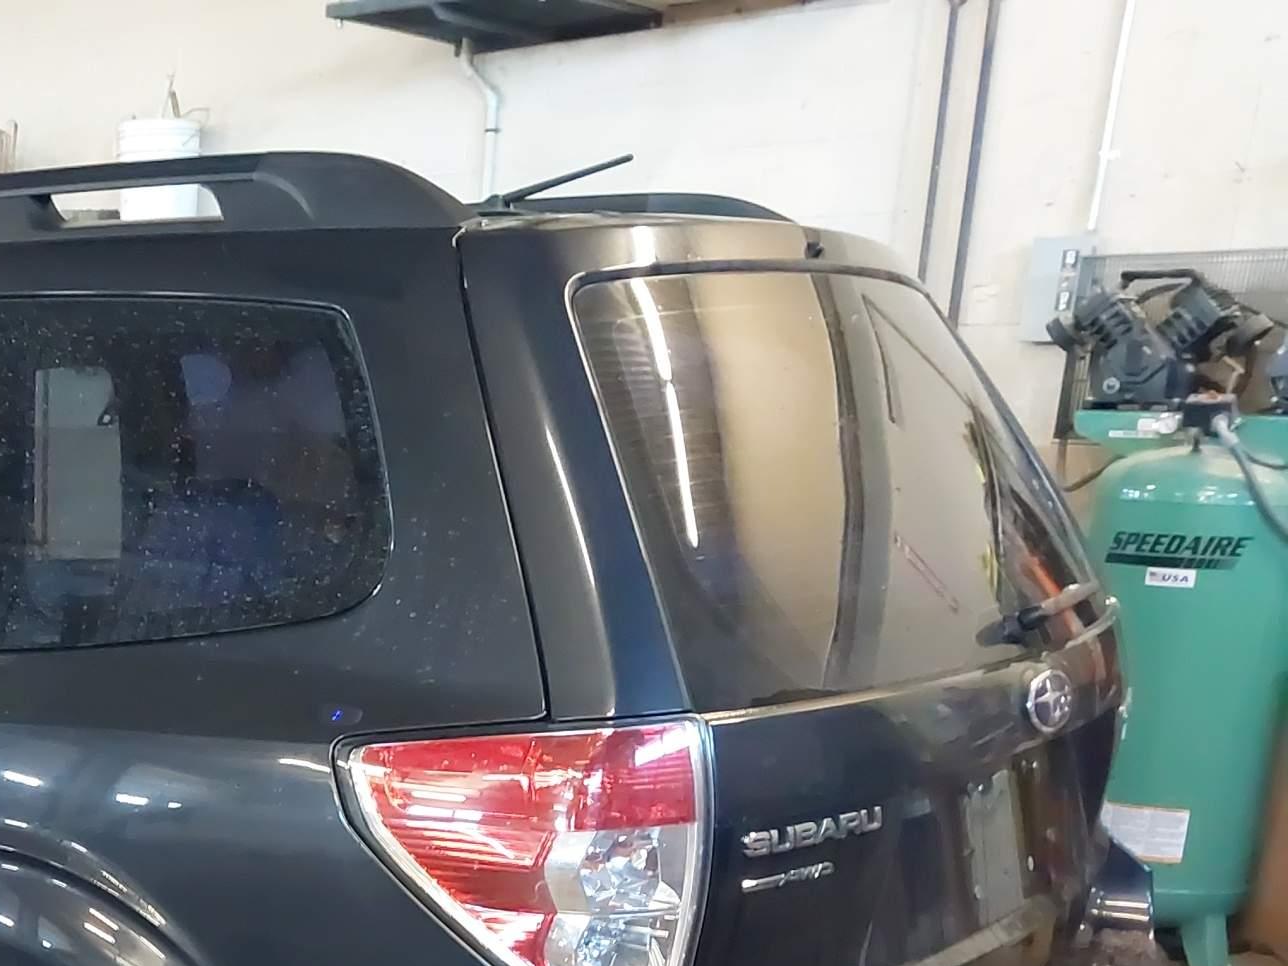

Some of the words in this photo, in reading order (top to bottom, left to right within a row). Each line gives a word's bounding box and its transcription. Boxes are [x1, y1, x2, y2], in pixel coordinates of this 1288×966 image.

[1110, 530, 1255, 558] SPEEDAIRE
[1162, 573, 1189, 584] USA
[741, 805, 883, 858] SUBARU
